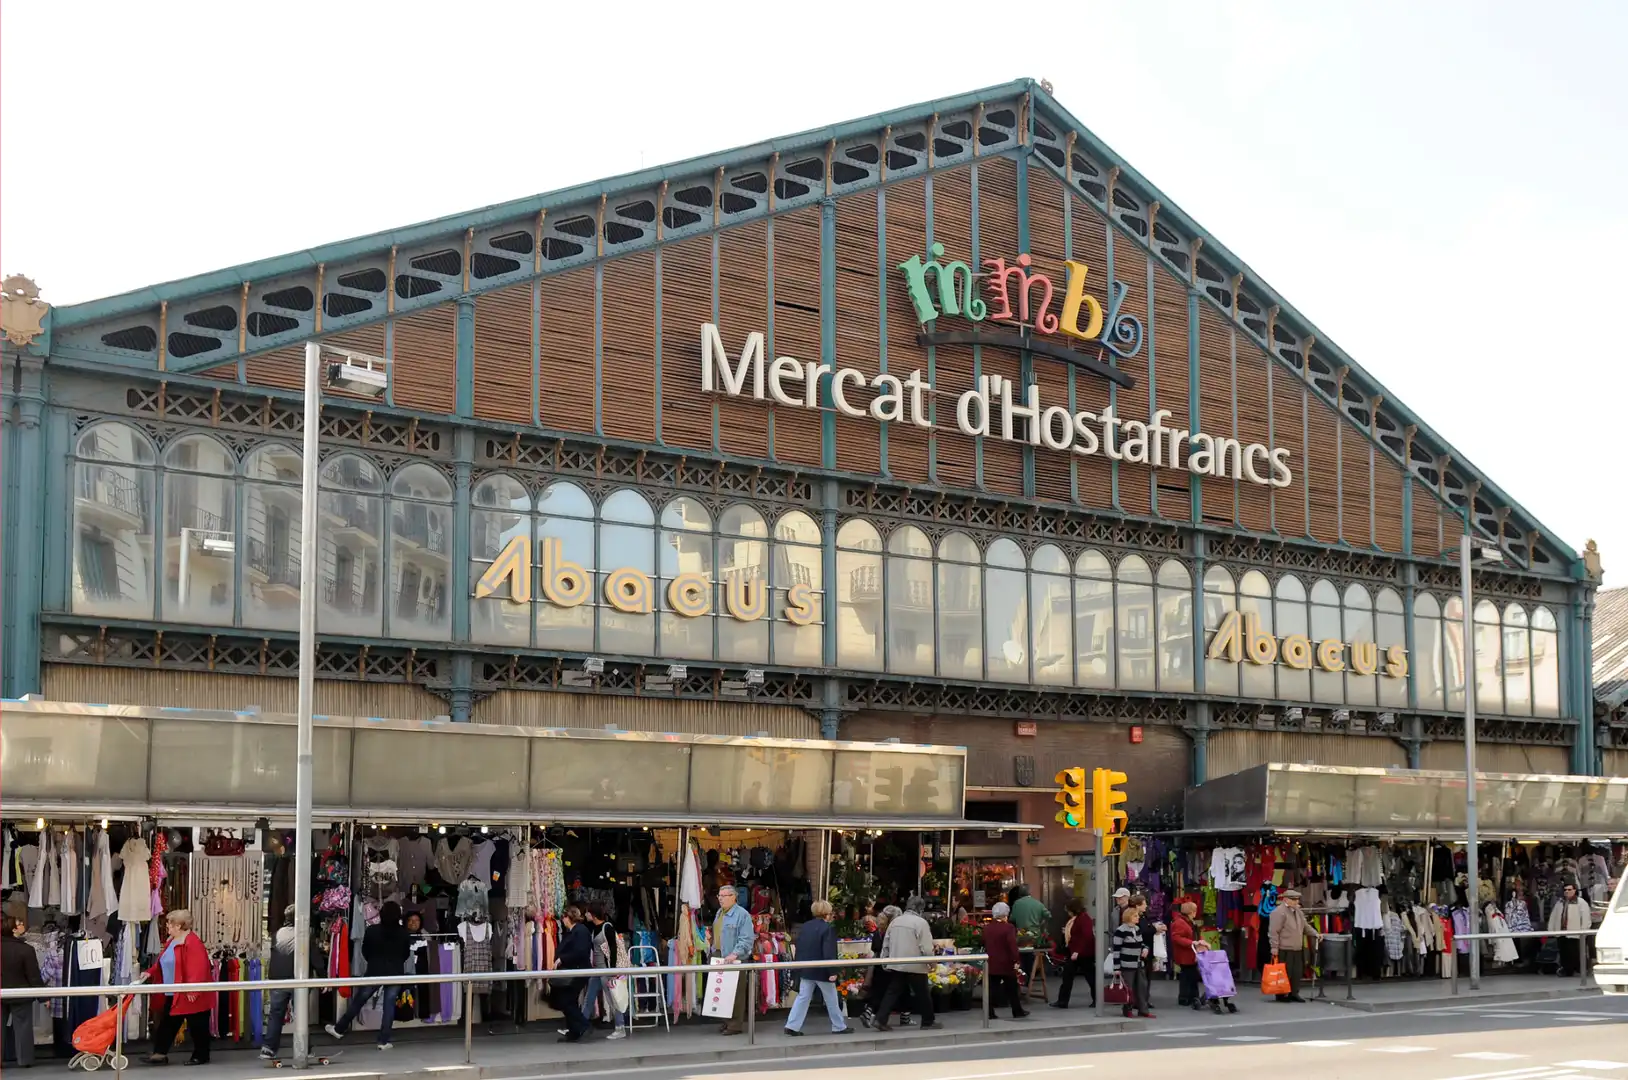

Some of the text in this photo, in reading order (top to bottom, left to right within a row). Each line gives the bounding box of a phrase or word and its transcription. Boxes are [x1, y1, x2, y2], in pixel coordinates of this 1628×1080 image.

[701, 322, 1293, 488] Mercat d'Hostafrancs
[475, 535, 819, 626] Abacus
[1207, 610, 1408, 679] Abacus
